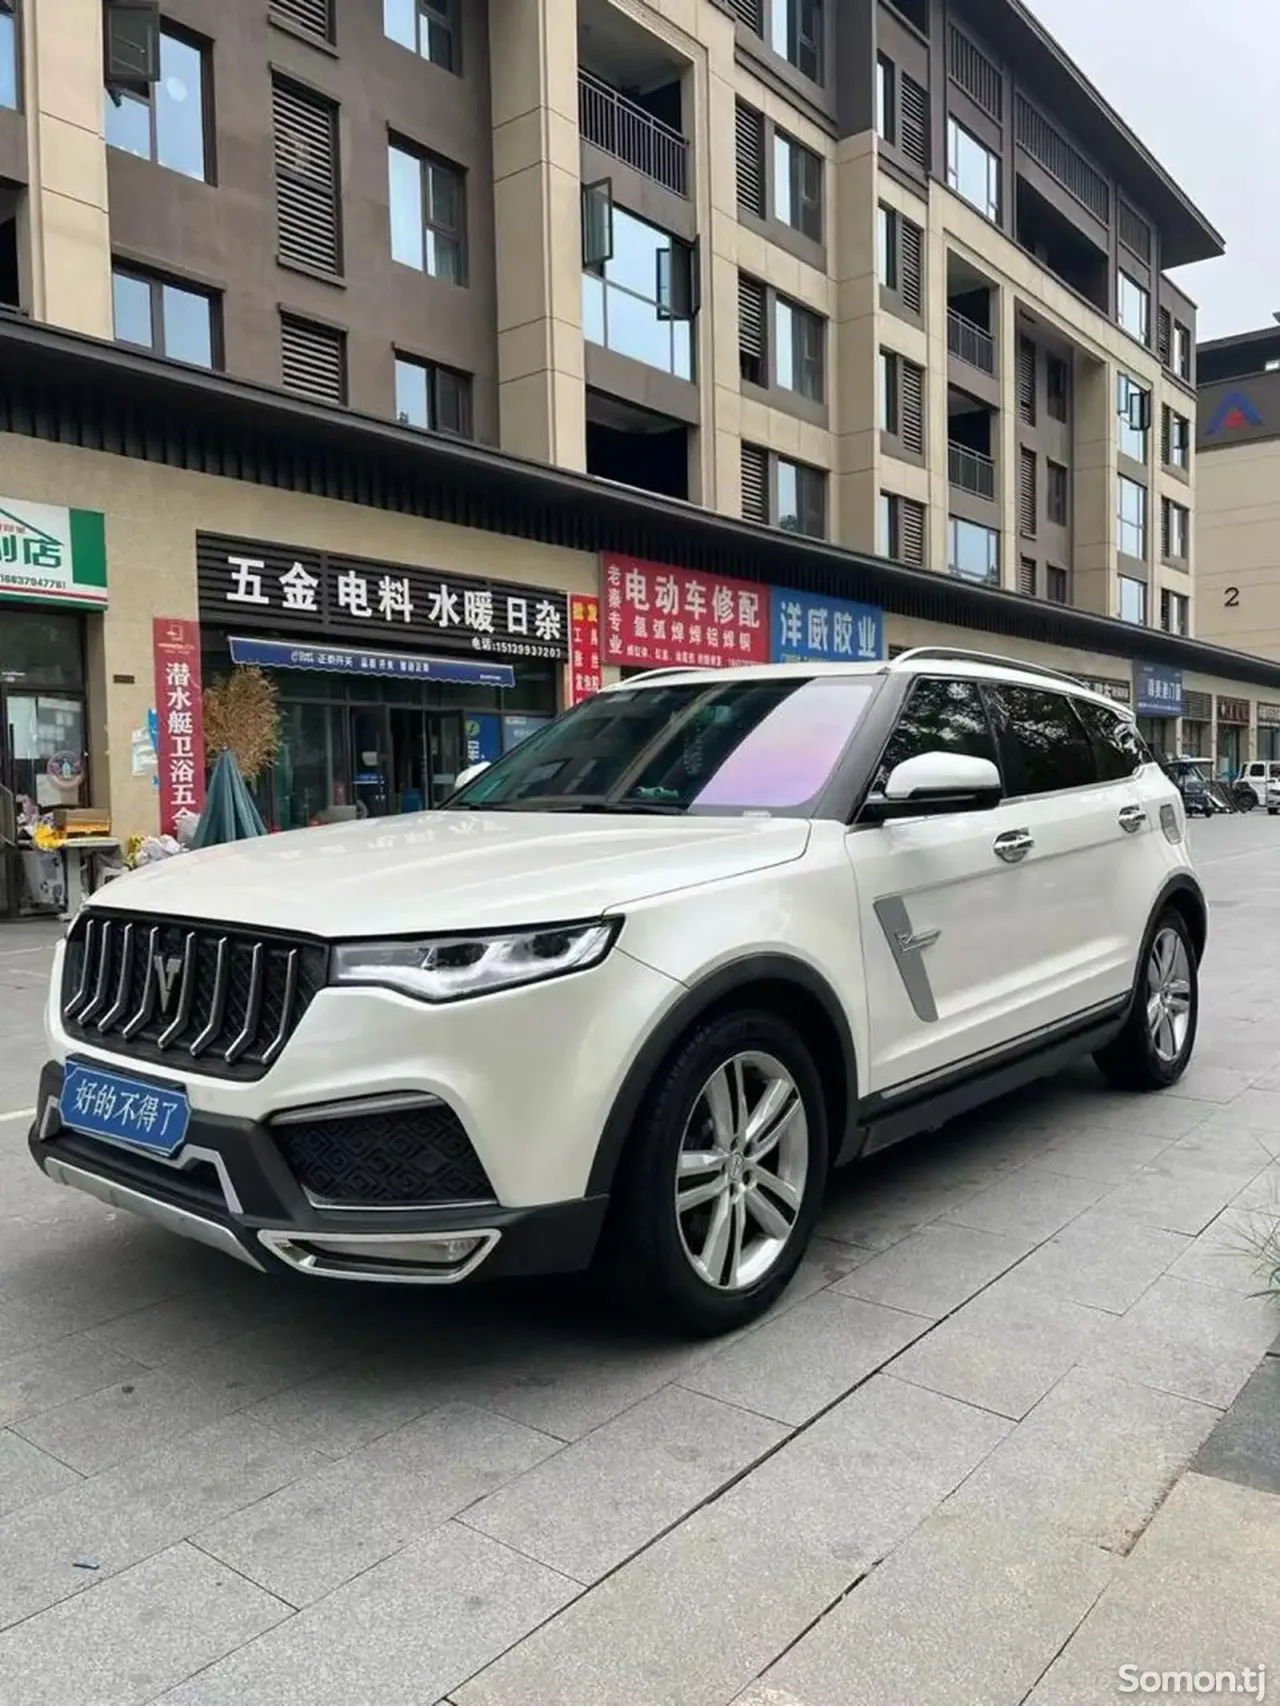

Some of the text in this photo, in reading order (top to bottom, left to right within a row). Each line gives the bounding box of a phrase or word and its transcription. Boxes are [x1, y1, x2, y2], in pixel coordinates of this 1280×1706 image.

[226, 555, 562, 641] 五金 电料 水暖 日杂
[625, 568, 760, 628] 电动车修配
[1224, 587, 1240, 608] 2
[780, 601, 876, 658] 洋威胶业
[72, 1078, 178, 1135] 好的不得了
